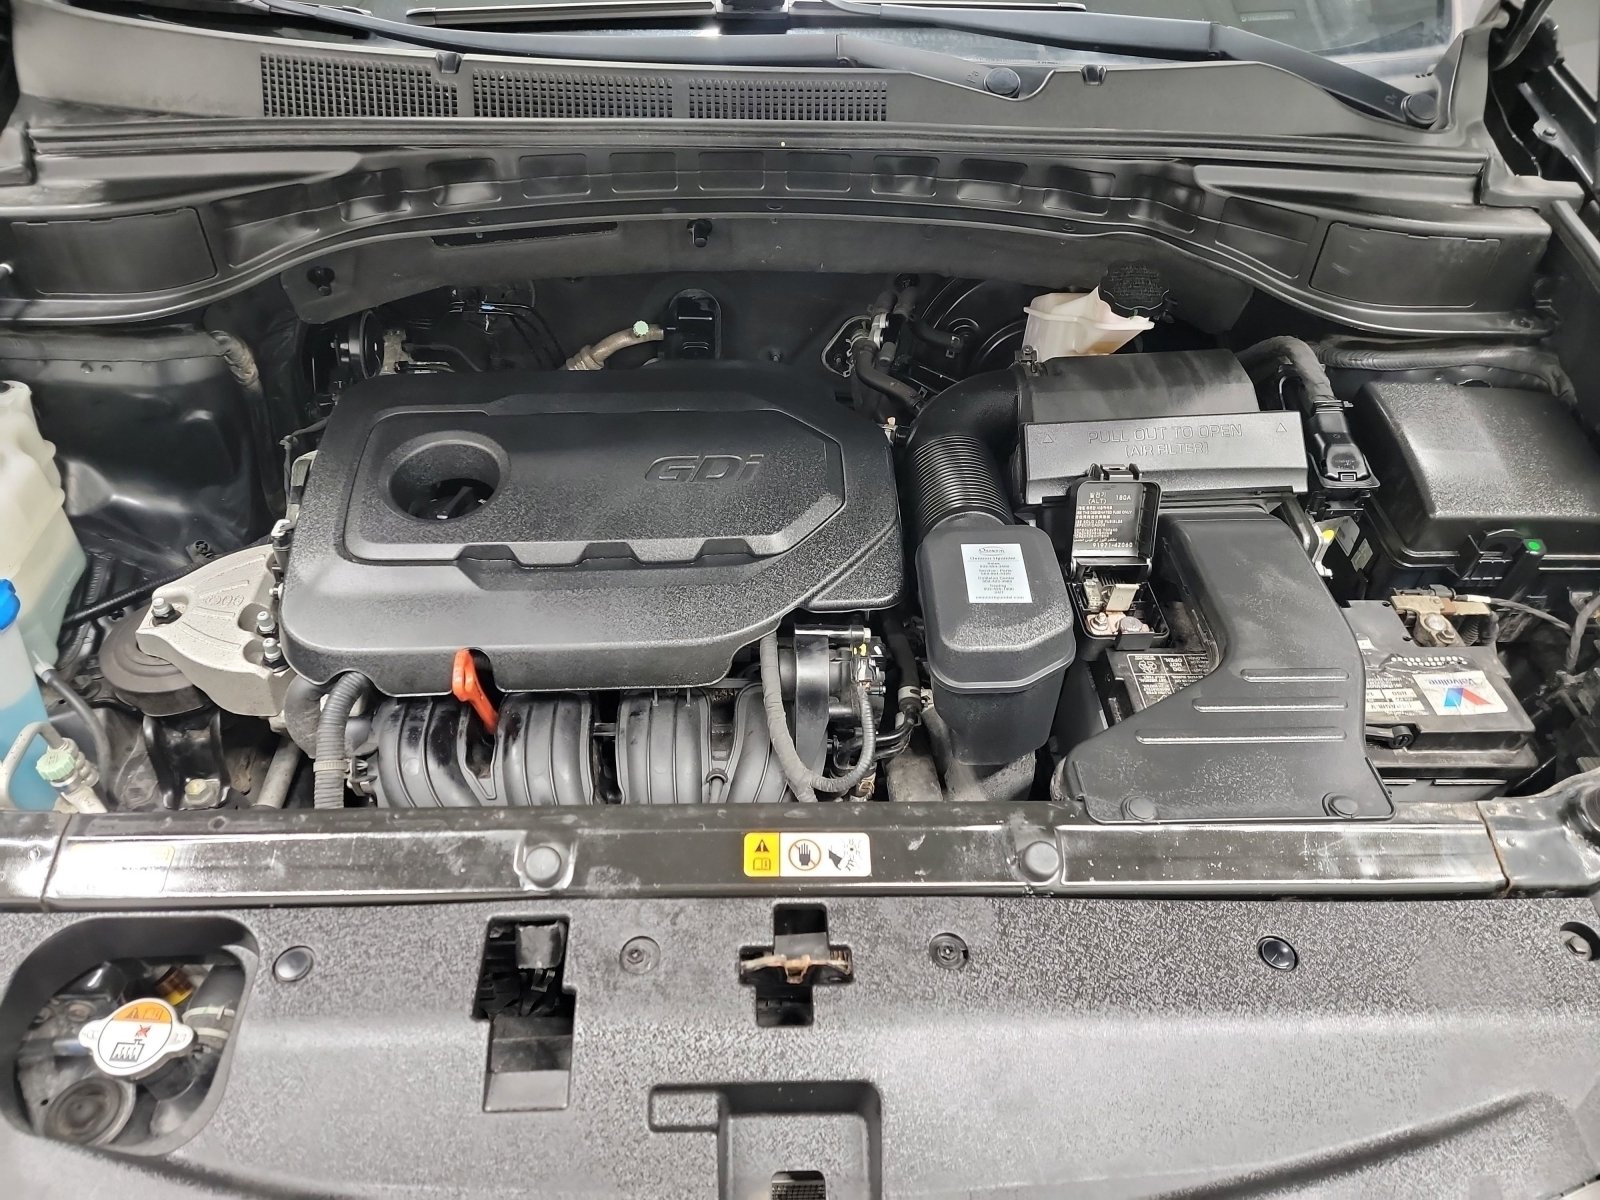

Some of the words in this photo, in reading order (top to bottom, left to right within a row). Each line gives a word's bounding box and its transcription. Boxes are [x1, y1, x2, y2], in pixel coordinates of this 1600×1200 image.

[1088, 430, 1129, 444] PULL
[1133, 427, 1166, 442] OUT
[1174, 425, 1194, 439] TO
[1199, 424, 1242, 438] OPEN
[1124, 444, 1154, 458] (AIR
[1157, 442, 1209, 456] FILTER)
[644, 454, 764, 482] GDi
[1428, 678, 1476, 687] Valvoline
